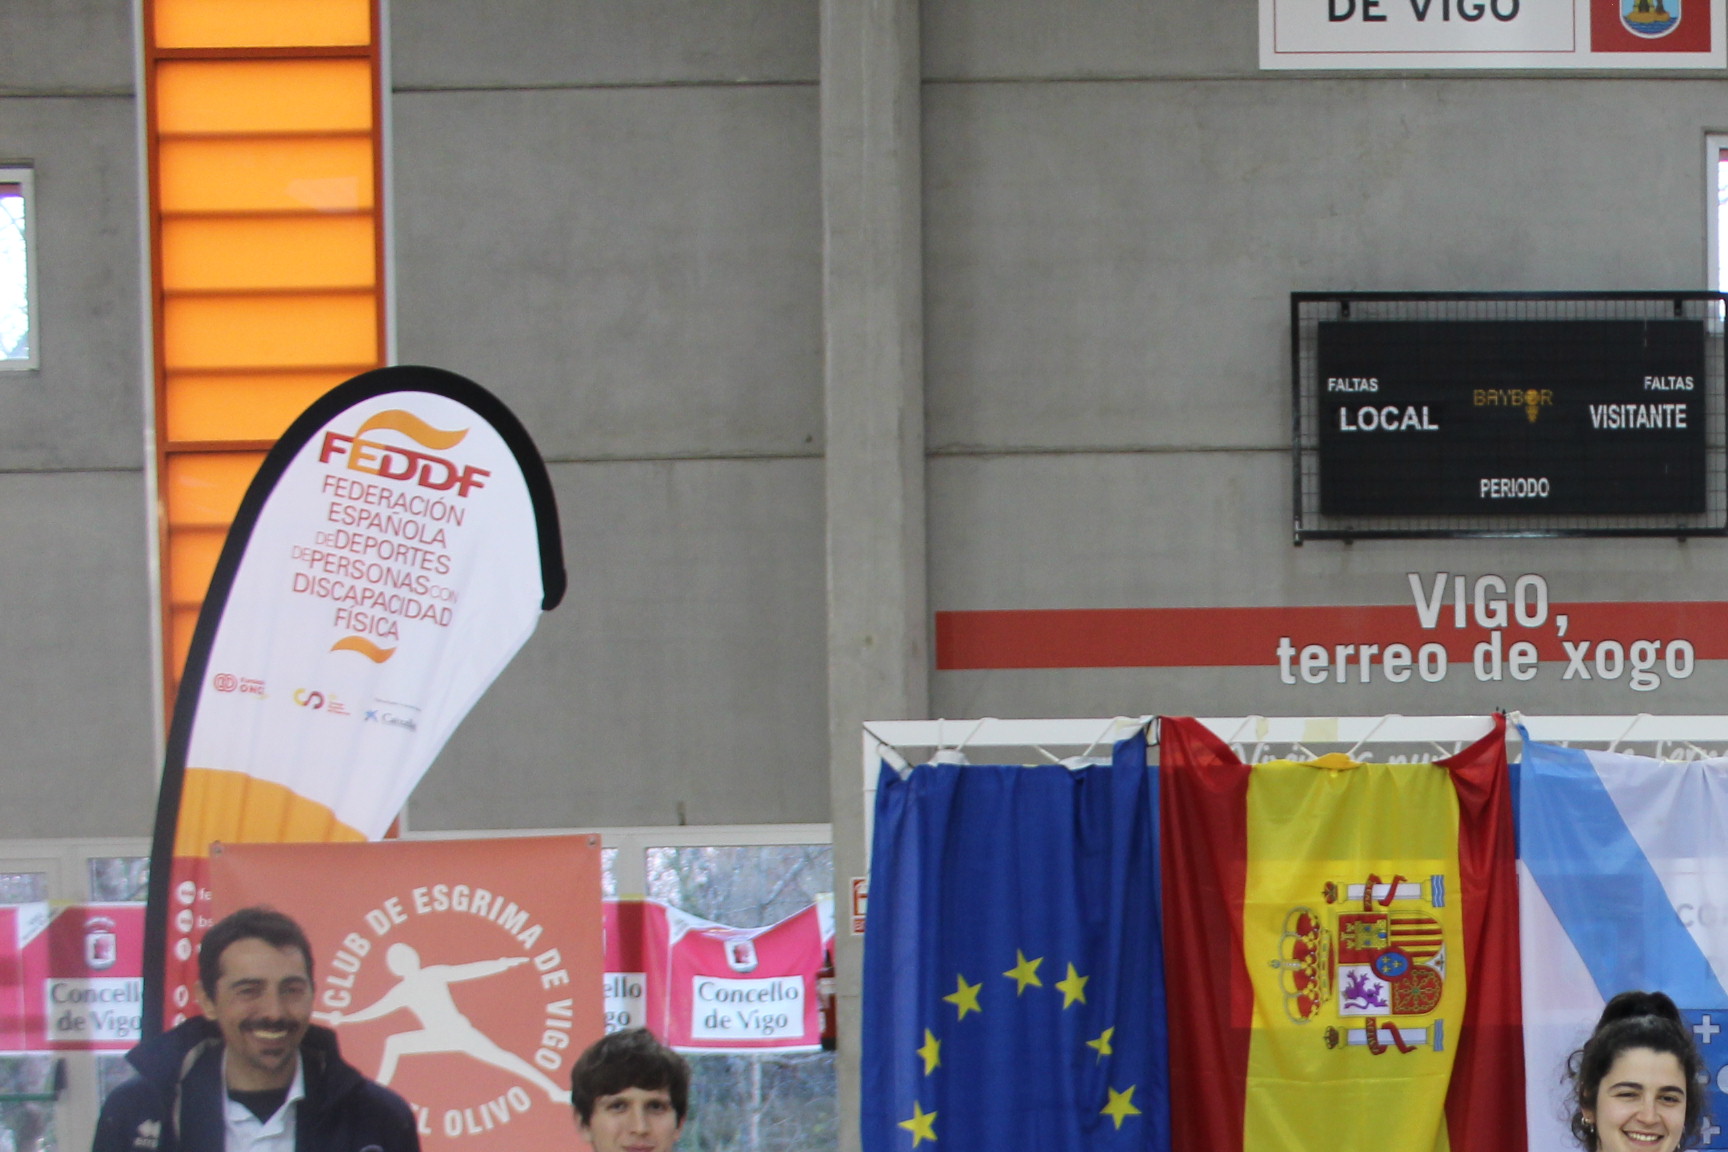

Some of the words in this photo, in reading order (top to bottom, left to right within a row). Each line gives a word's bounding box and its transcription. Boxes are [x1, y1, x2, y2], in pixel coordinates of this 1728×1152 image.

[1327, 0, 1387, 21] DE
[1411, 0, 1520, 22] VIGO
[1327, 377, 1378, 393] FALTAS
[1644, 376, 1694, 391] FALTAS
[1339, 406, 1438, 432] LOCAL
[1590, 403, 1687, 429] VISITANTE
[319, 431, 491, 497] FEDDF
[323, 475, 465, 526] FEDERACIÓN
[1480, 478, 1550, 499] PERIODO
[328, 502, 447, 549] ESPAÑOLA
[292, 572, 453, 627] DISCAPACIDAD
[1407, 573, 1569, 637] VIGO,
[334, 605, 399, 641] FÍSICA
[1277, 636, 1447, 685] terreo
[1473, 630, 1538, 681] de
[1562, 637, 1696, 692] xogo
[364, 896, 408, 936] DE
[412, 884, 543, 949] ESGRIMA
[323, 932, 372, 1008] CLUB
[534, 947, 570, 990] DE
[51, 982, 142, 1004] Concell
[604, 976, 641, 999] ello
[699, 982, 798, 1003] Concello
[56, 1010, 86, 1031] de
[534, 998, 573, 1070] VIGO
[604, 1011, 631, 1032] go
[705, 1009, 732, 1029] de
[739, 1010, 788, 1036] Vigo
[412, 1103, 431, 1135] L
[444, 1085, 531, 1137] OLIVO
